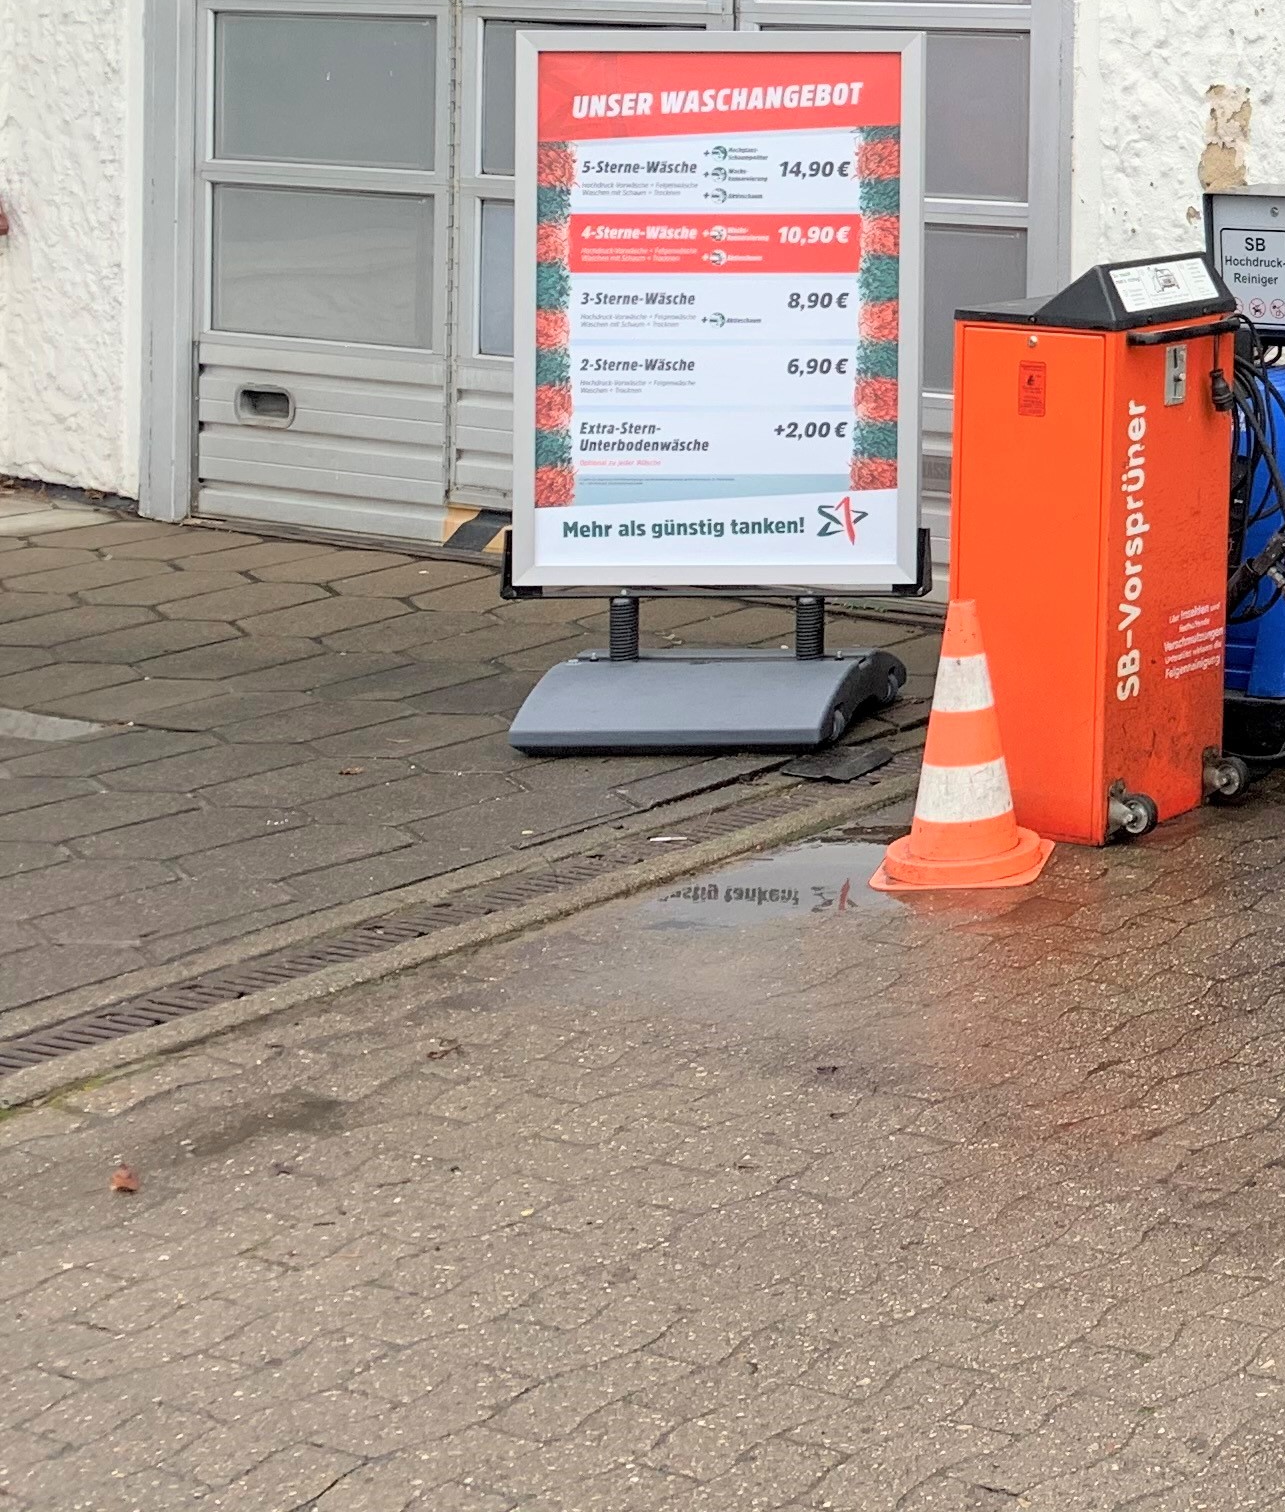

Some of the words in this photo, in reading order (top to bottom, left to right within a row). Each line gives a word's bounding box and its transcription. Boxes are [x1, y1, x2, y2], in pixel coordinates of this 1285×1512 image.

[572, 92, 653, 119] UNSER
[660, 82, 864, 114] WASCHANGEBOT
[582, 160, 698, 175] 5-Sterne-Wäsche
[779, 160, 834, 179] 14,90
[837, 160, 851, 177] €
[581, 225, 698, 240] 4-Sterne-Wäsche
[778, 226, 834, 246] 10,90
[836, 226, 851, 243] €
[1244, 237, 1266, 252] SB
[1234, 272, 1279, 287] Reiniger
[581, 292, 696, 306] 3-Sterne-Wäsche
[787, 292, 833, 311] 8,90
[836, 292, 850, 309] €
[580, 358, 695, 372] 2-Sterne-Wäsche
[787, 358, 832, 377] 6,90
[835, 358, 849, 375] €
[579, 422, 661, 435] Extra-Stern-
[773, 422, 831, 441] +2,00
[834, 422, 848, 438] €
[579, 438, 710, 452] Unterbodenwäsche
[562, 520, 612, 538] Mehr
[618, 519, 646, 538] als
[652, 518, 725, 539] günstig
[730, 516, 805, 535] tanken!
